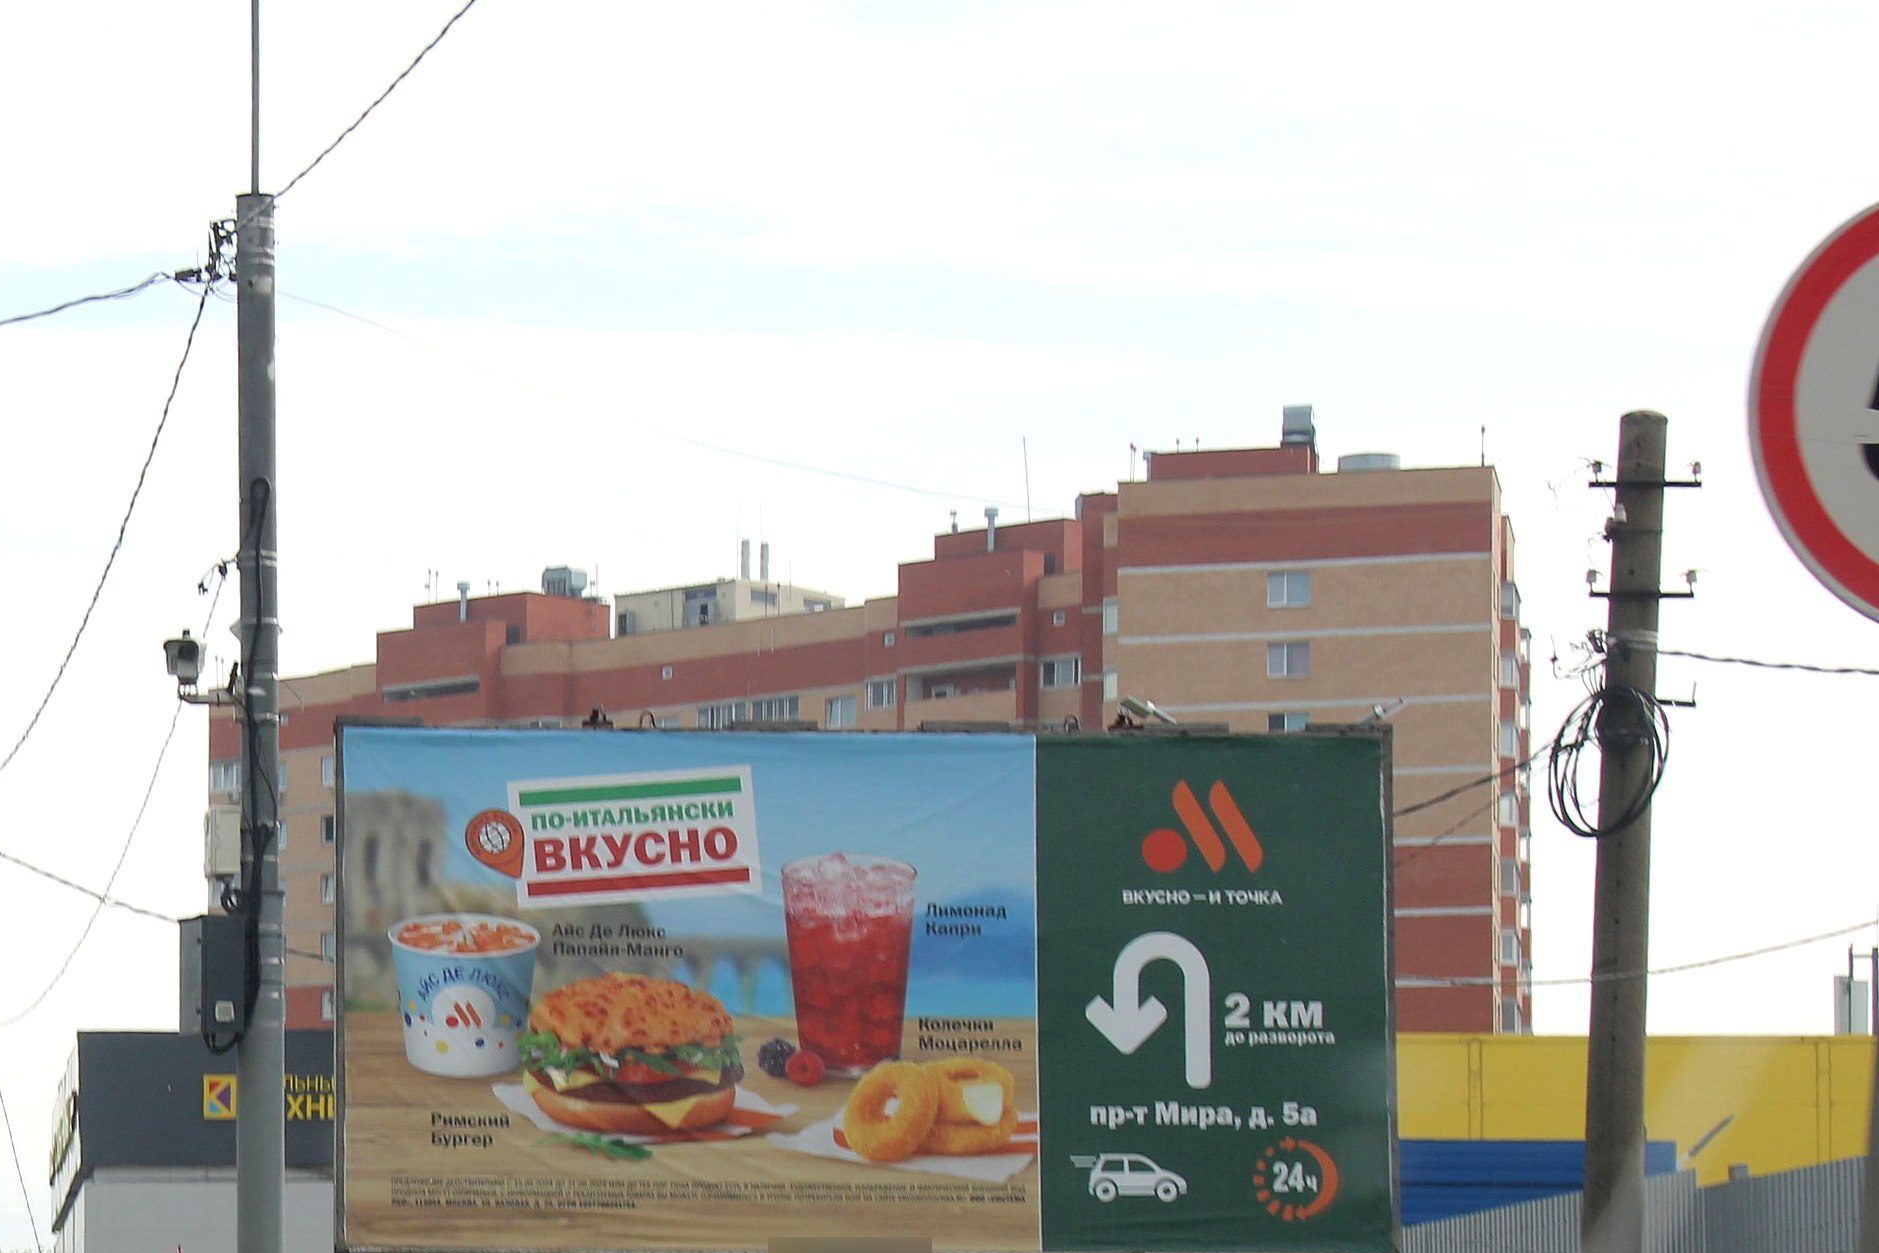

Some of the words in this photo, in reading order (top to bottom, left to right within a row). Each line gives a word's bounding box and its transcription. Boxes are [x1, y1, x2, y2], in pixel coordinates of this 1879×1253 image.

[531, 800, 734, 831] ПО-ИТАЛЬЯНСКИ
[533, 825, 739, 874] ВКУСНО
[1122, 889, 1191, 905] ВКУСНО
[1208, 890, 1221, 905] И
[1225, 890, 1283, 905] ТОЧКА
[925, 902, 1008, 920] Лимонад
[590, 923, 613, 940] Де
[618, 923, 666, 939] Люкс
[925, 922, 982, 938] Капри
[1224, 992, 1251, 1028] 2
[918, 1017, 995, 1032] Колечки
[919, 1036, 1023, 1052] Моцарелла
[1224, 1031, 1246, 1046] до
[1249, 1031, 1336, 1046] разворота
[430, 1112, 510, 1128] Римский
[1089, 1104, 1148, 1130] пр-т
[1154, 1101, 1241, 1130] Мира,
[1248, 1106, 1274, 1130] д.
[1282, 1101, 1318, 1126] 5а
[431, 1132, 494, 1149] Бургер
